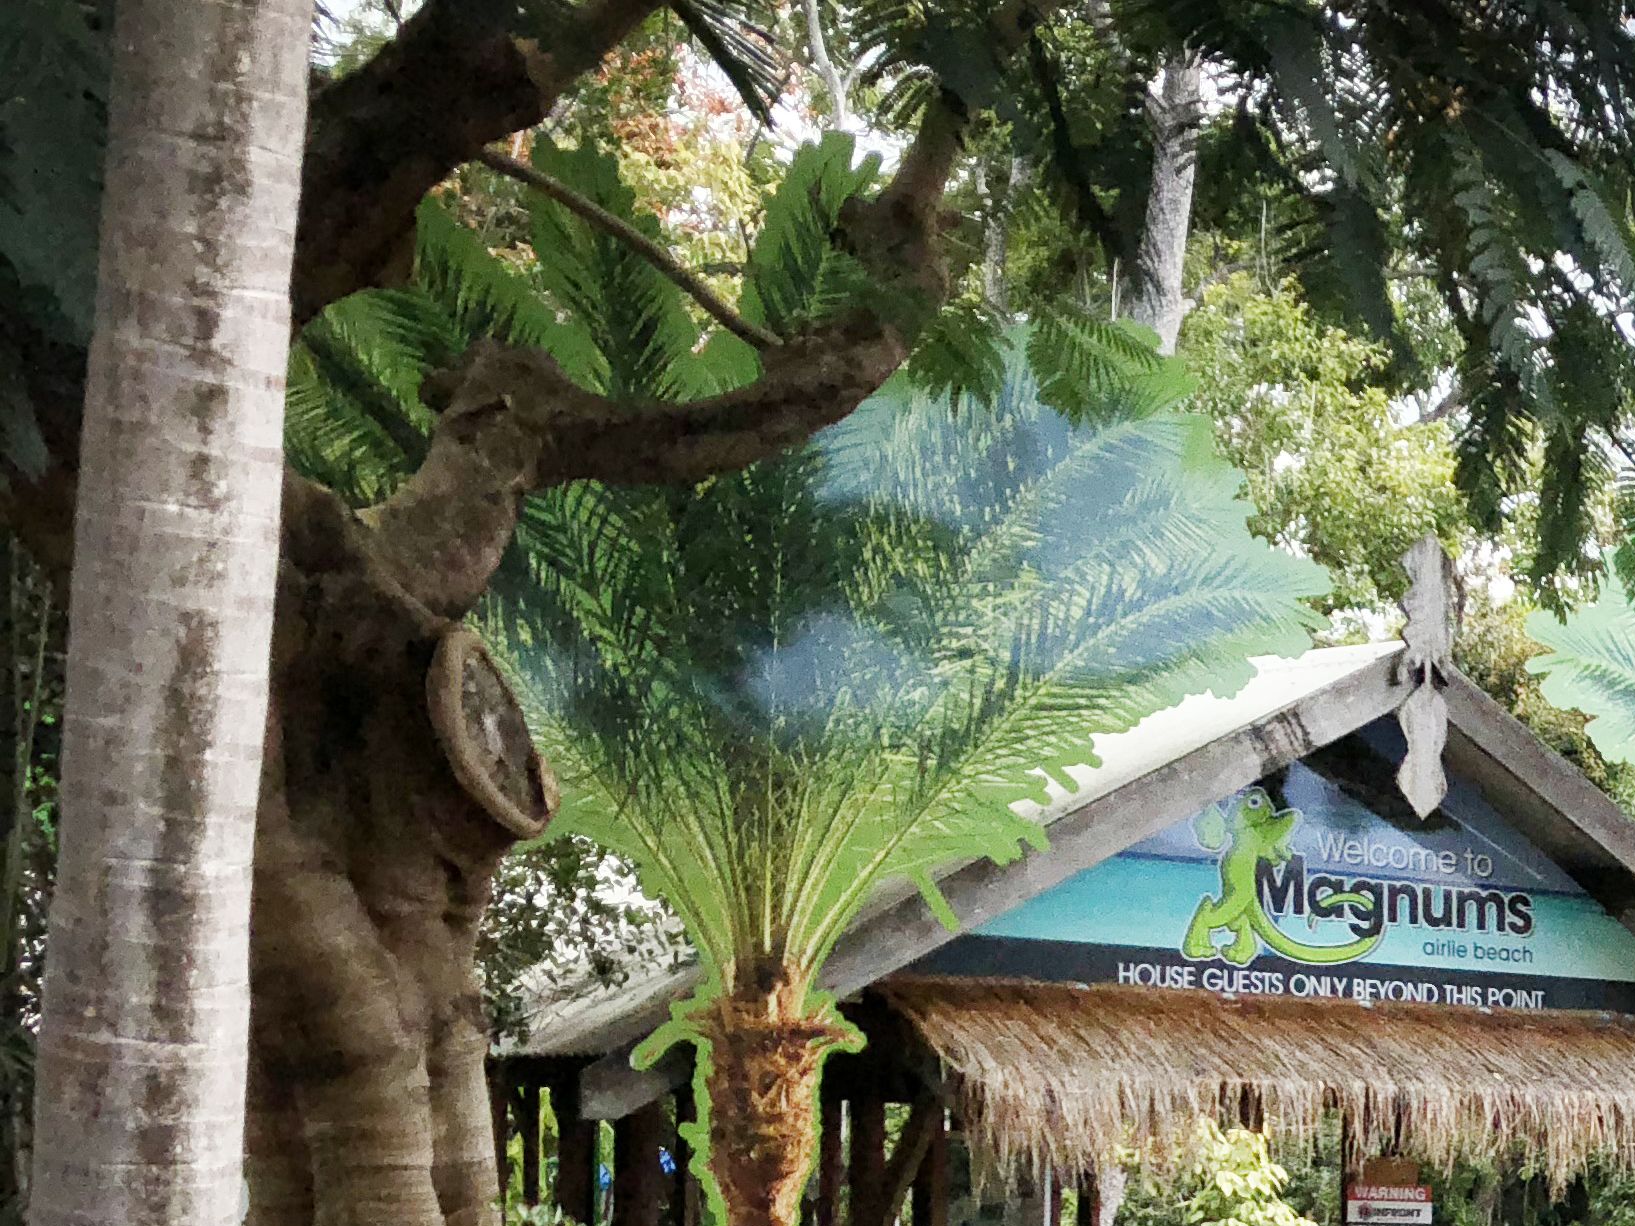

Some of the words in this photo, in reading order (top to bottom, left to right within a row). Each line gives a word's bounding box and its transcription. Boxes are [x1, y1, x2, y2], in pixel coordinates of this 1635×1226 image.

[1317, 831, 1457, 874] Welcome
[1465, 848, 1493, 878] to
[1255, 853, 1533, 938] Magnums
[1422, 939, 1468, 957] airlie
[1473, 943, 1534, 963] beach
[1117, 962, 1196, 989] HOUSE
[1202, 968, 1284, 994] GUESTS
[1289, 974, 1347, 998] ONLY
[1353, 978, 1439, 1004] BEYOND
[1443, 984, 1484, 1006] THIS
[1487, 988, 1546, 1010] POINT
[1354, 1186, 1427, 1200] WARNING
